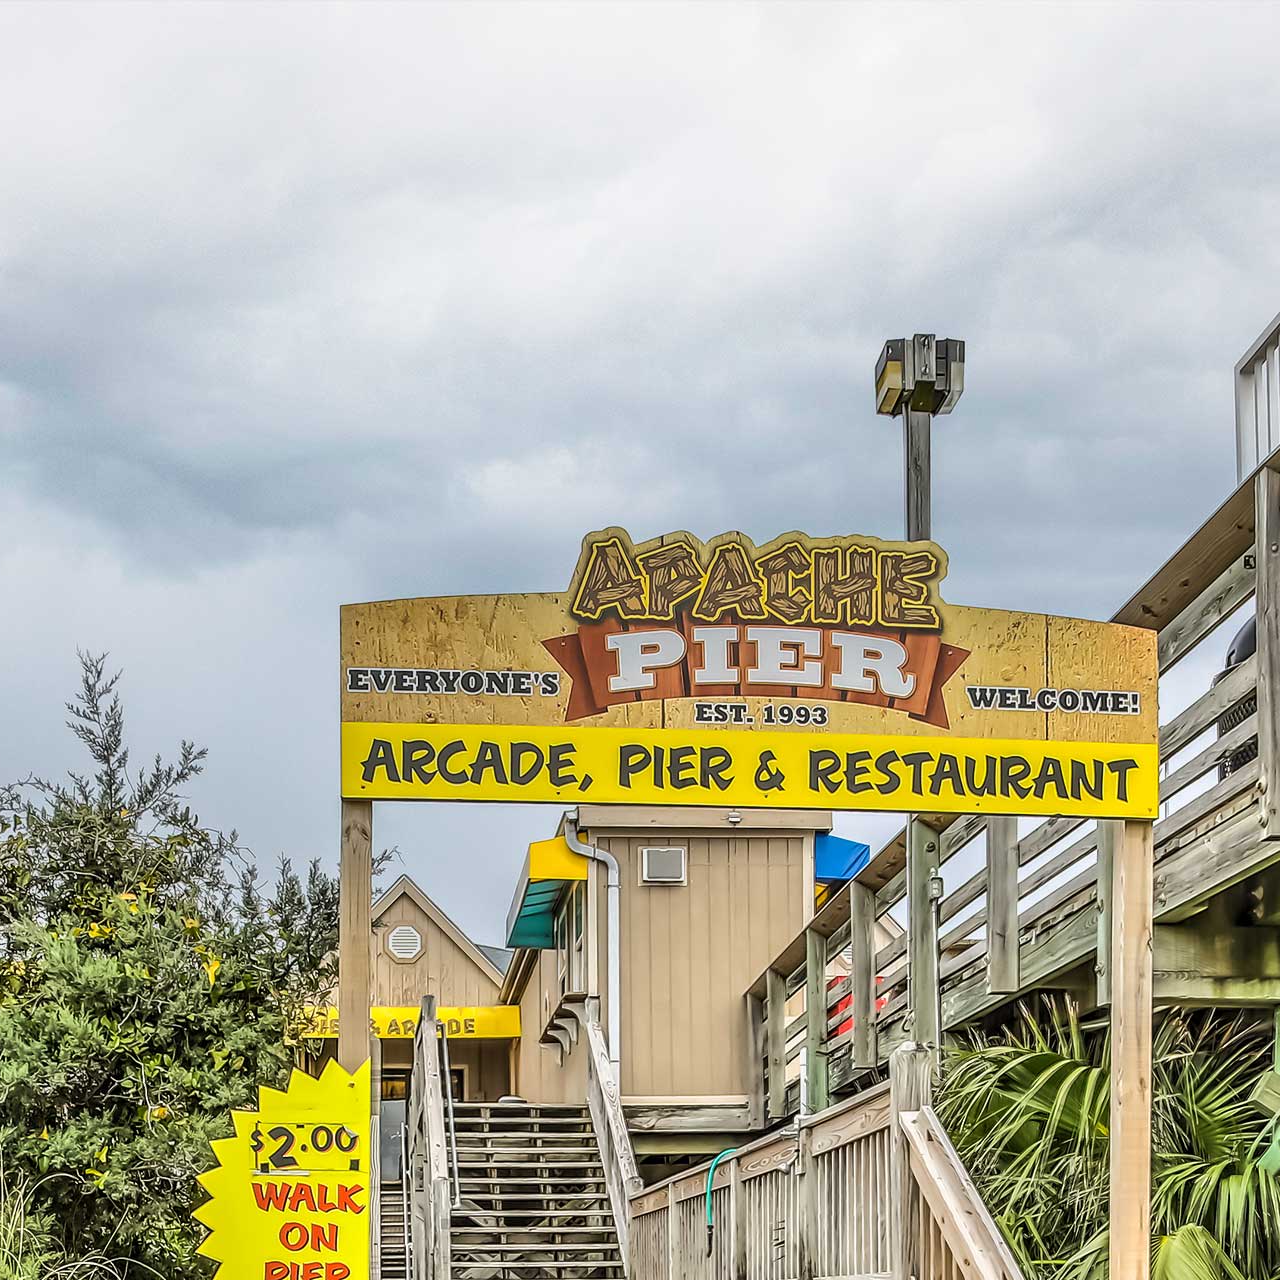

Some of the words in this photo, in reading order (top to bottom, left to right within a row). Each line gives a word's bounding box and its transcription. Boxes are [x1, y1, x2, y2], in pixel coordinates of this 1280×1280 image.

[572, 538, 941, 629] APACHE
[605, 626, 917, 698] PIER
[347, 669, 559, 695] EVERYONE'S
[695, 704, 754, 723] EST.
[763, 704, 828, 725] 1993
[967, 687, 1140, 713] WELCOME!
[361, 738, 593, 792] ARCADE,
[619, 743, 735, 791] PIER
[754, 750, 785, 791] &
[809, 750, 1140, 803] RESTAURANT
[250, 1121, 359, 1169] $2.00
[251, 1182, 366, 1214] WALK
[279, 1222, 338, 1252] ON
